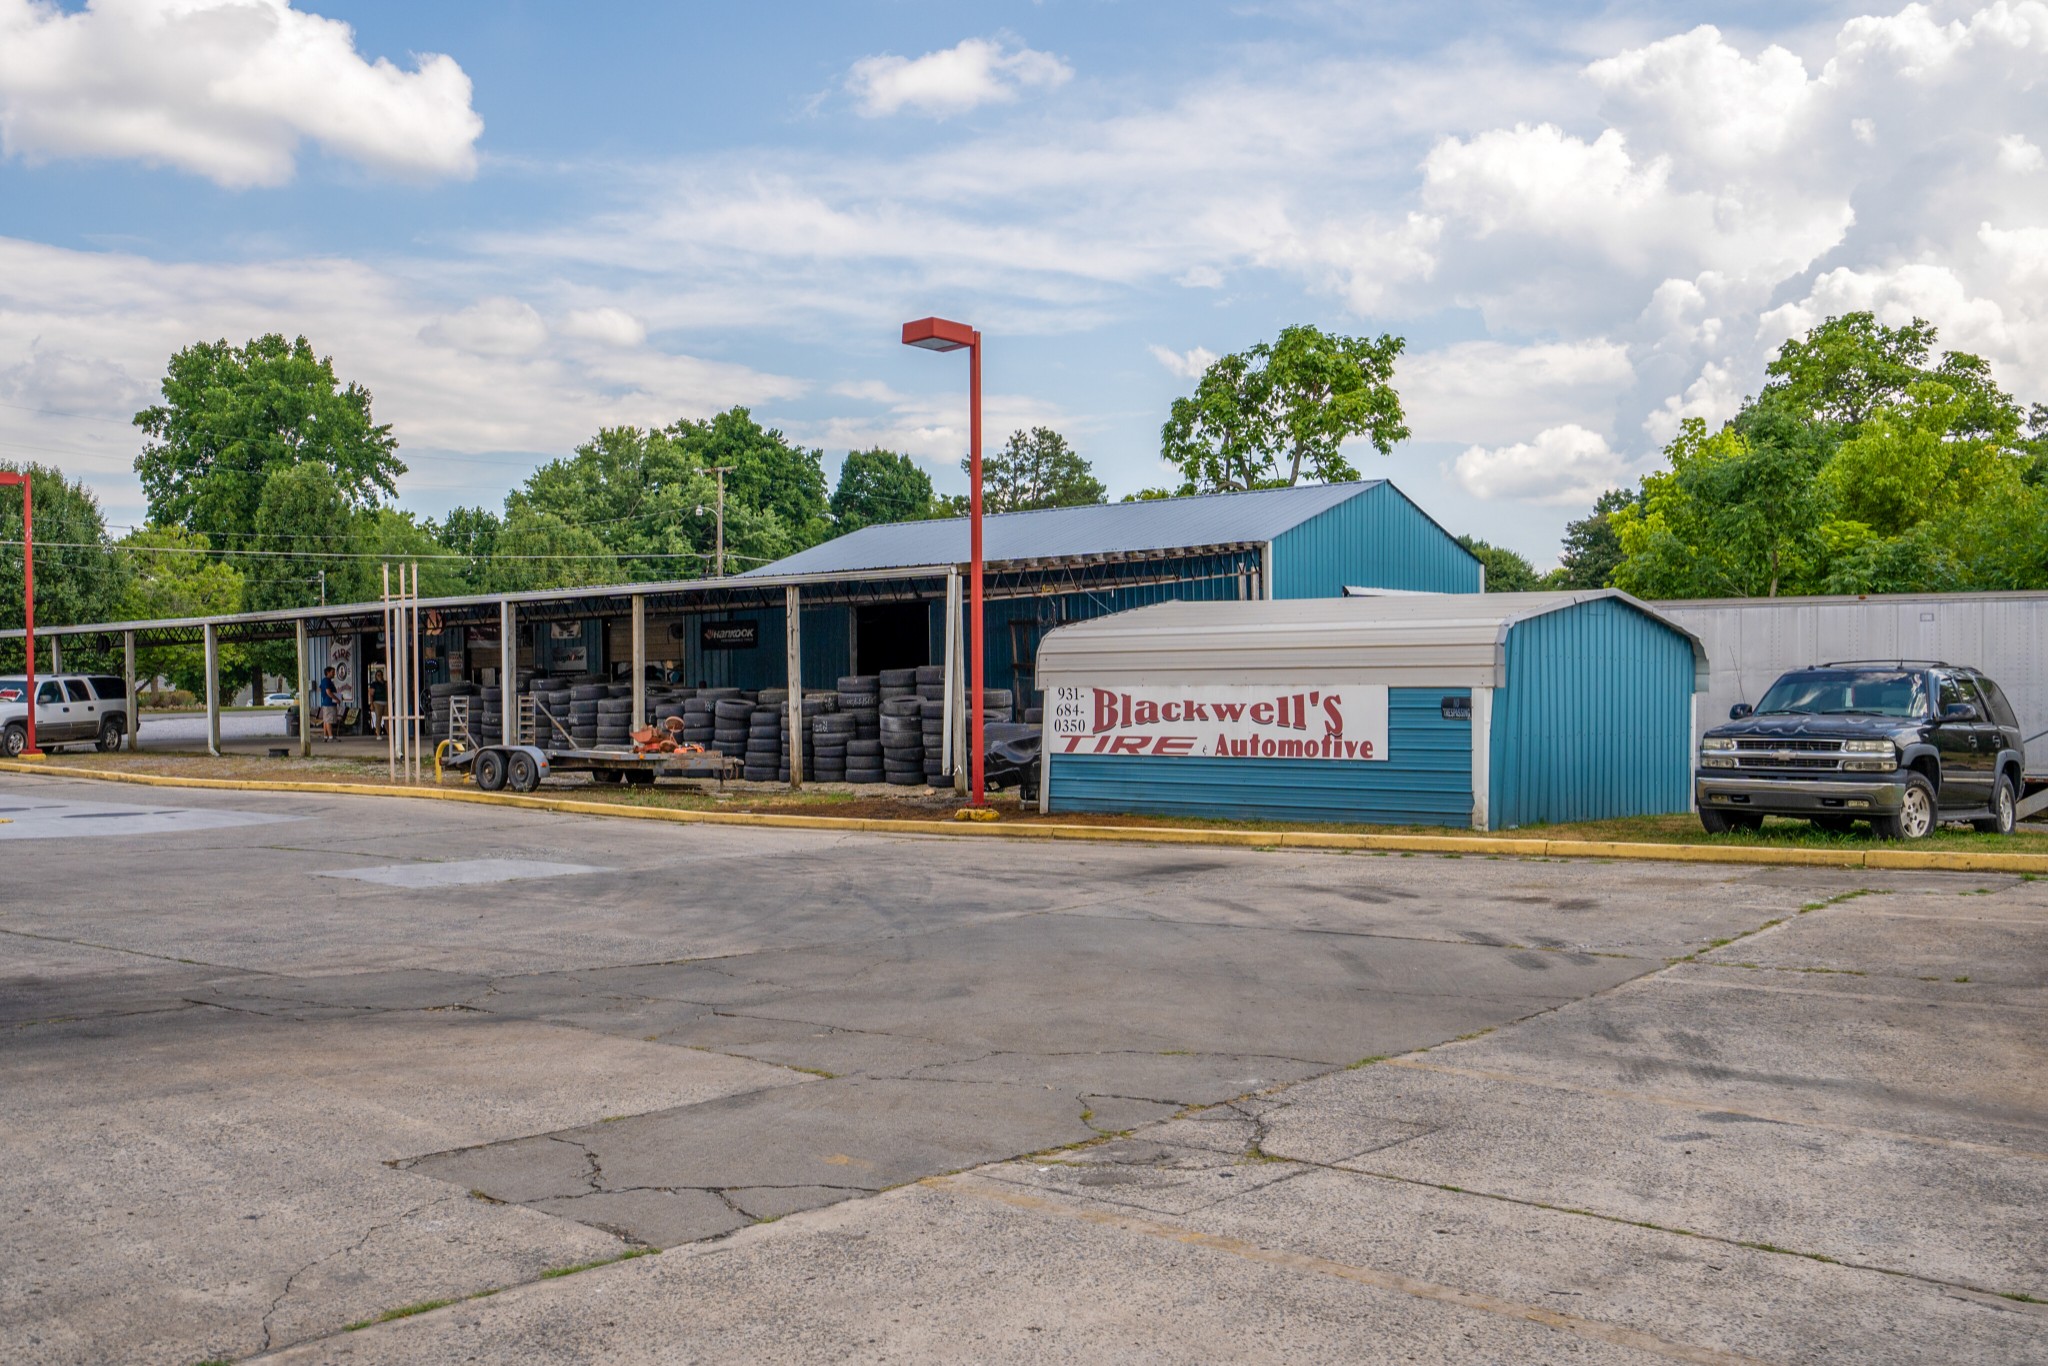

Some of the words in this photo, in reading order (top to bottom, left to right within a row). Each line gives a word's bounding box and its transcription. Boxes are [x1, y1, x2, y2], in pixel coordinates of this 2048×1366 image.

[332, 648, 351, 661] TIRE
[1058, 687, 1084, 701] 931-
[1056, 703, 1084, 717] 684-
[1054, 719, 1086, 733] 0350
[1060, 735, 1198, 755] TIRE
[1215, 733, 1374, 759] Automotive
